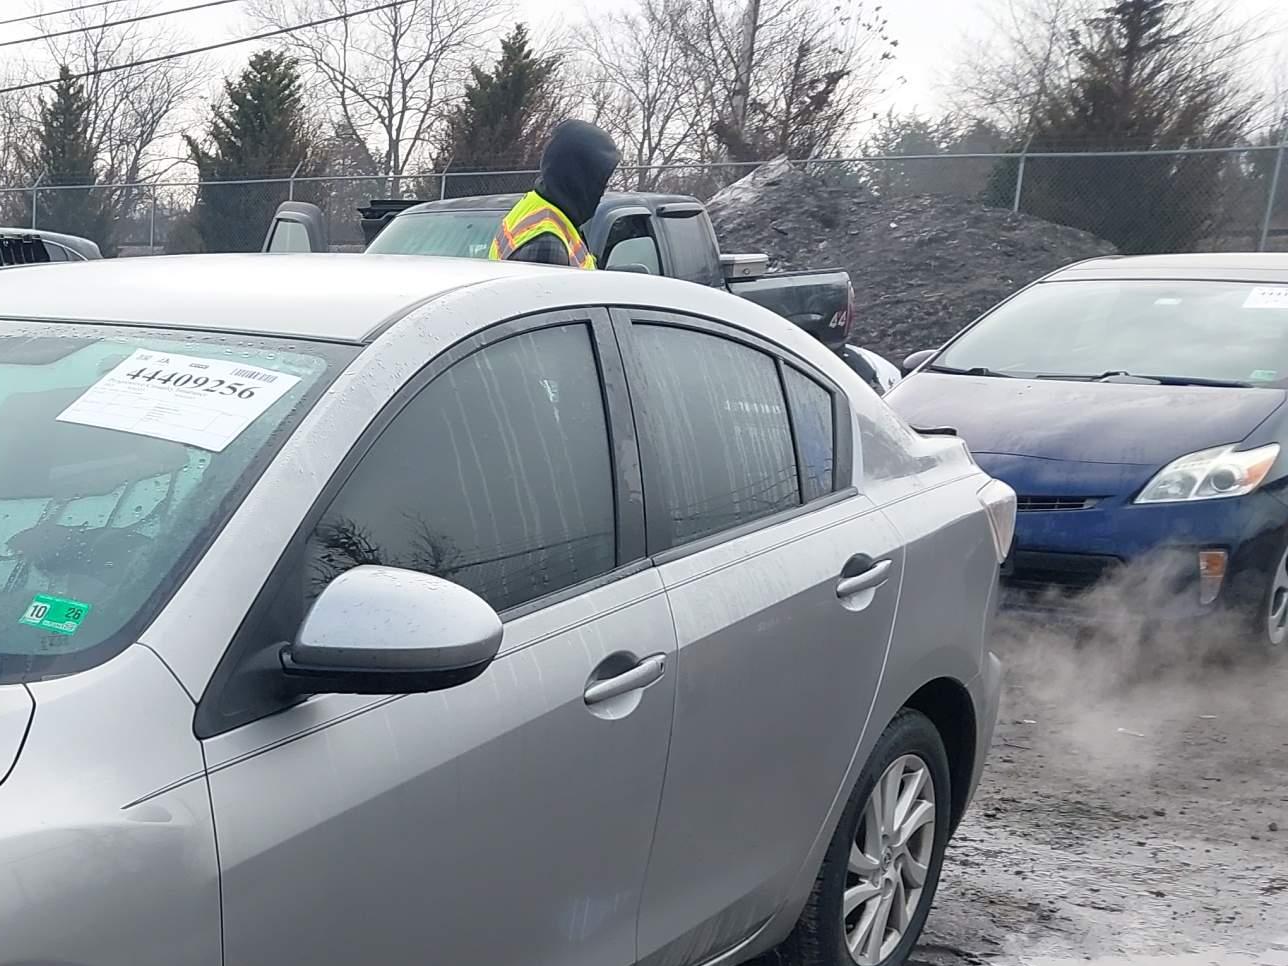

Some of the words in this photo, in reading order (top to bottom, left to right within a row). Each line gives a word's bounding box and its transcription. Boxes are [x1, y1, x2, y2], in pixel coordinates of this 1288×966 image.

[126, 367, 263, 400] 44409256
[30, 604, 48, 618] 10
[65, 607, 83, 620] 26
